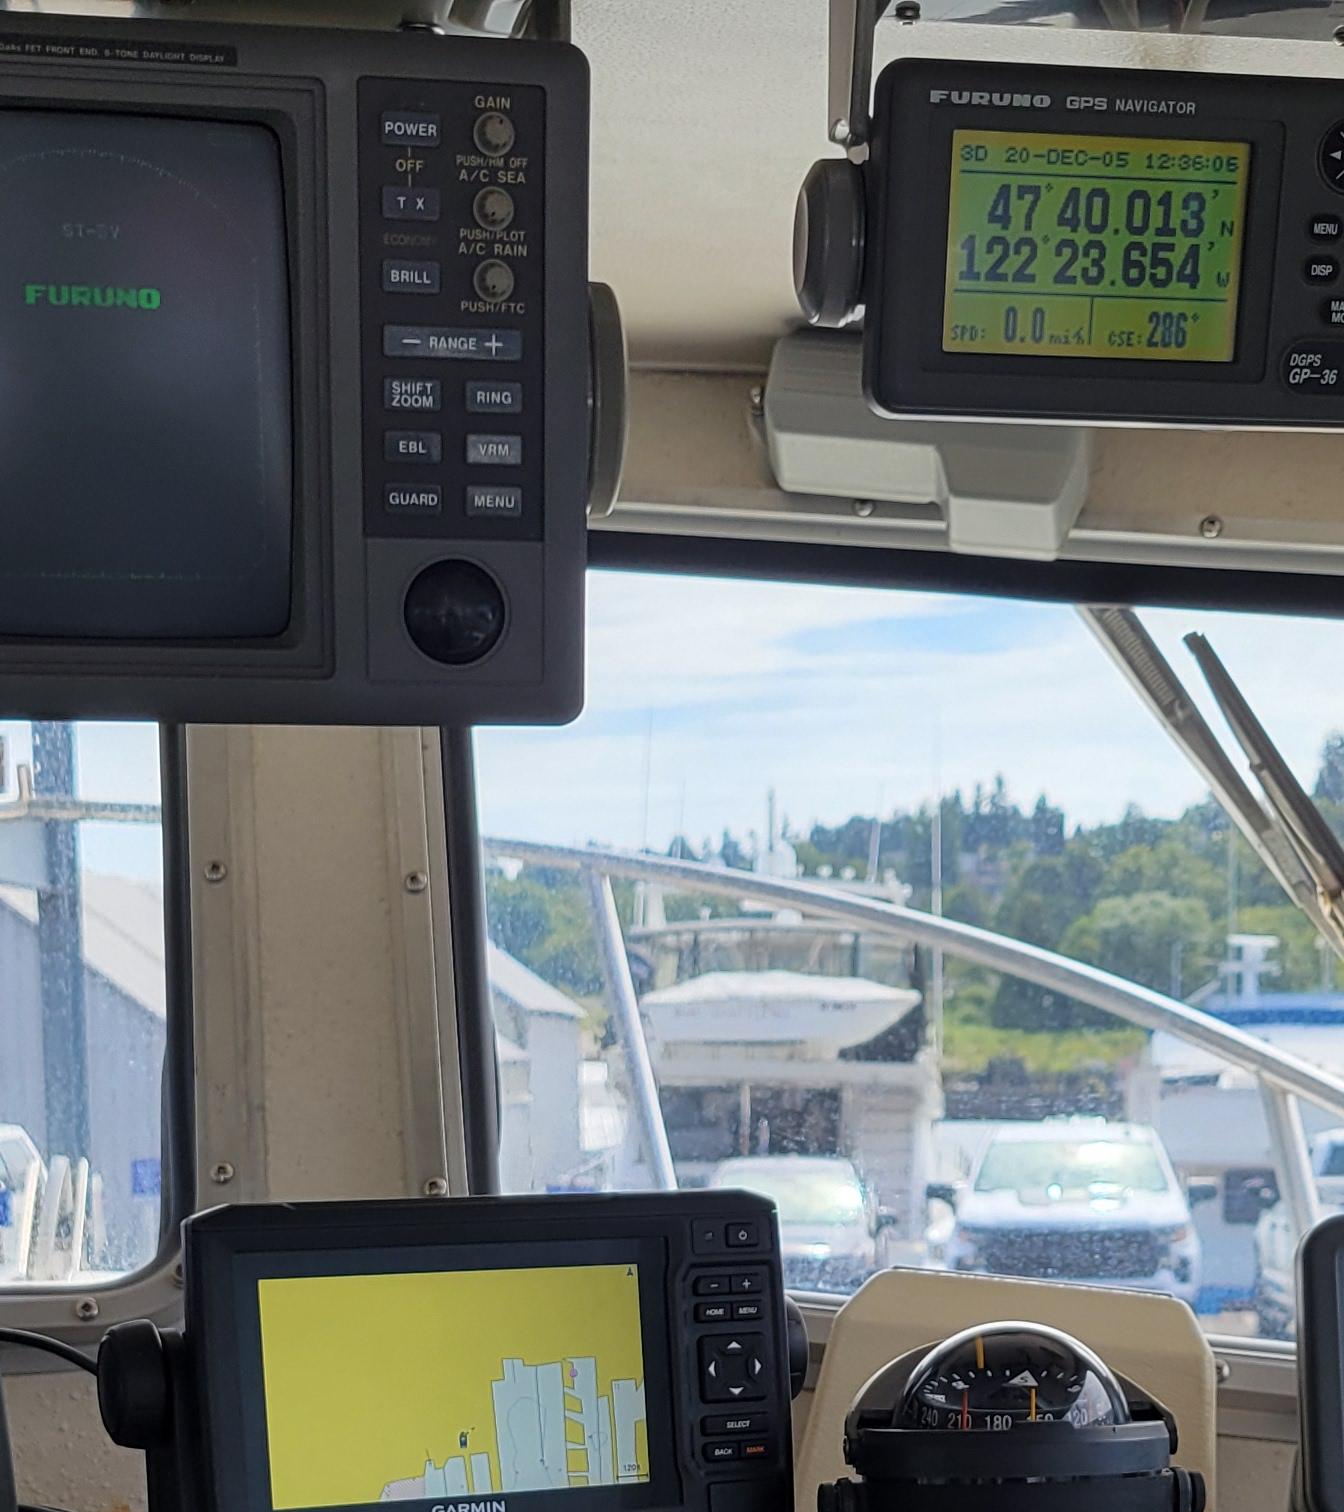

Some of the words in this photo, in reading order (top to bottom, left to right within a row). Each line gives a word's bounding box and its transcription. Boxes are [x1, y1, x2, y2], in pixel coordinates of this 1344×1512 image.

[143, 51, 184, 61] DAYLIGHT
[190, 53, 225, 63] DISPLAY
[474, 96, 511, 109] GAIN
[929, 89, 1051, 108] FURUNO
[1066, 96, 1107, 110] GPS
[1115, 99, 1196, 116] NAVIGATOR
[385, 122, 437, 137] POWER
[960, 144, 988, 162] 3D
[1004, 147, 1130, 168] 20-DEC-05
[395, 159, 424, 172] OFF
[509, 158, 528, 169] OFF
[459, 169, 489, 182] A/C
[498, 171, 526, 184] SEA
[459, 228, 526, 241] PUSH/PLOT
[1313, 223, 1338, 235] MENU
[458, 242, 485, 255] A/C
[494, 244, 528, 257] RAIN
[391, 269, 431, 284] BRILL
[1311, 264, 1333, 276] DISP
[23, 284, 161, 310] FURUNO
[460, 300, 526, 314] PUSH/FTC
[1003, 306, 1046, 344] 0.0
[429, 336, 477, 350] RANGE
[1289, 354, 1322, 367] DGPS
[1289, 368, 1338, 385] GP-36
[392, 381, 433, 395] SHIFT
[392, 395, 433, 408] ZOOM
[477, 391, 512, 405] RING
[399, 440, 427, 454] EBL
[479, 443, 509, 457] VRM
[389, 492, 438, 506] GUARD
[474, 495, 515, 508] MENU
[921, 1406, 938, 1427] 240
[985, 1415, 1012, 1431] 180
[726, 1420, 750, 1429] SELECT
[714, 1448, 733, 1456] BACK
